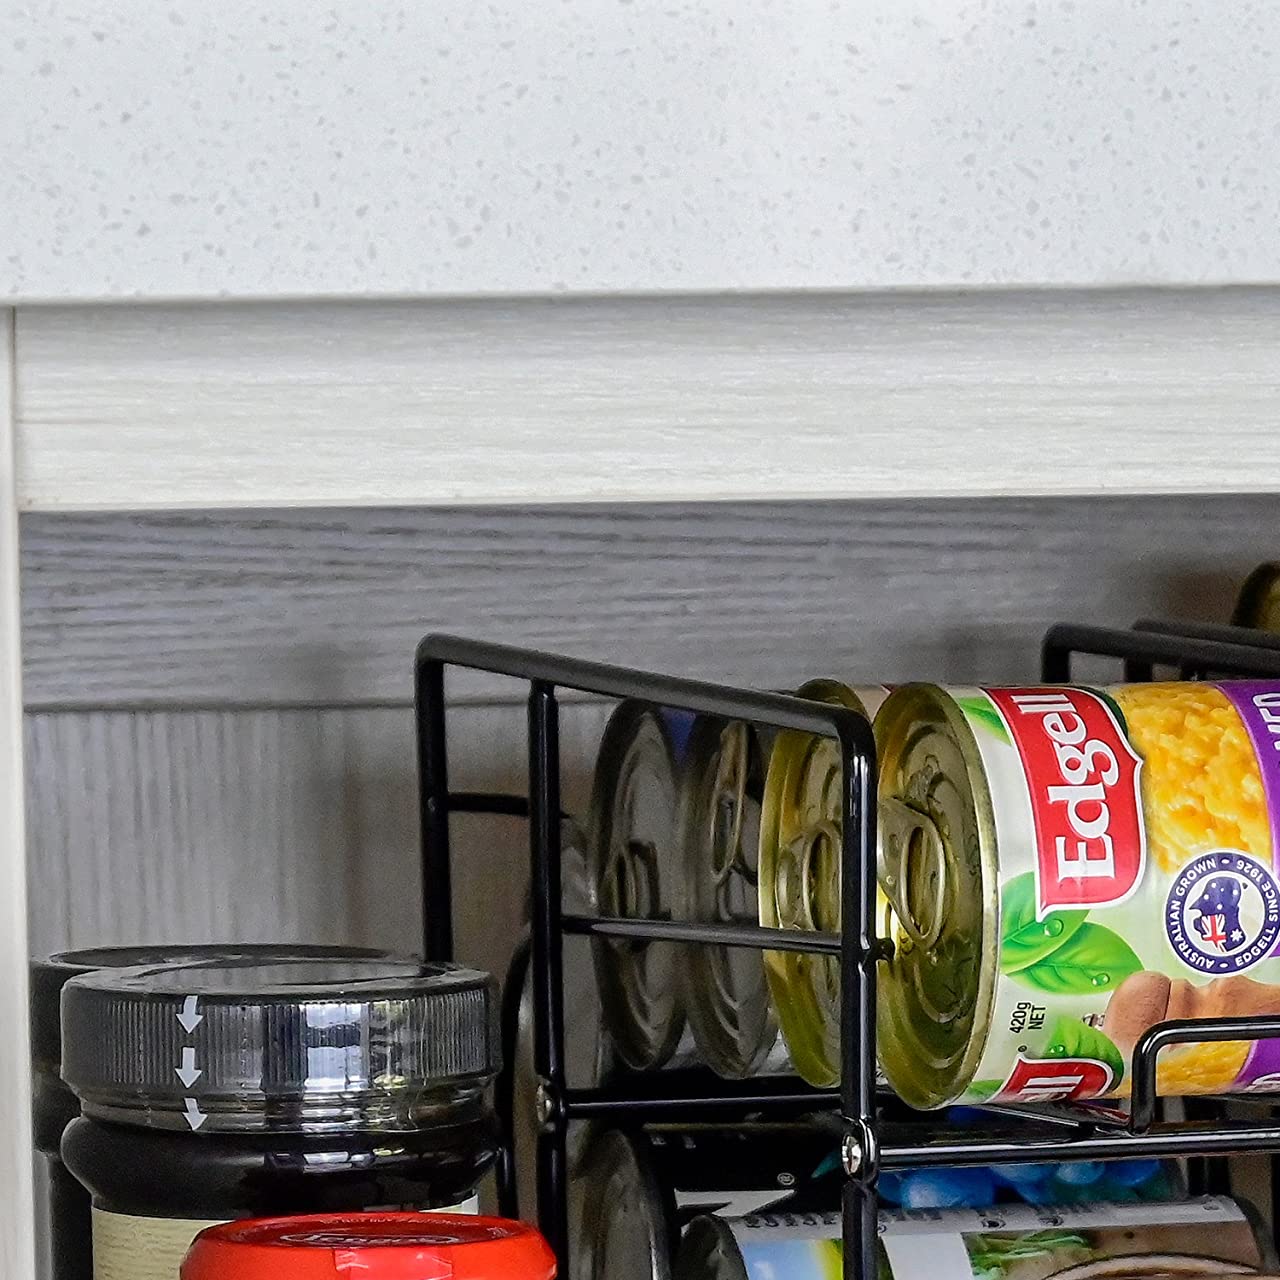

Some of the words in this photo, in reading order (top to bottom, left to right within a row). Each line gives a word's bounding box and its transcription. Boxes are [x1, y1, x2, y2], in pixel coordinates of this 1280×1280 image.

[1018, 691, 1121, 883] Edgell
[1175, 857, 1217, 896] GROWN
[1236, 859, 1264, 883] 1926
[1261, 880, 1279, 922] SINCE
[1169, 899, 1215, 970] AUSTRALIAN
[1235, 926, 1276, 967] EDGELL
[1009, 1001, 1032, 1034] 420g
[1028, 1005, 1047, 1030] NET
